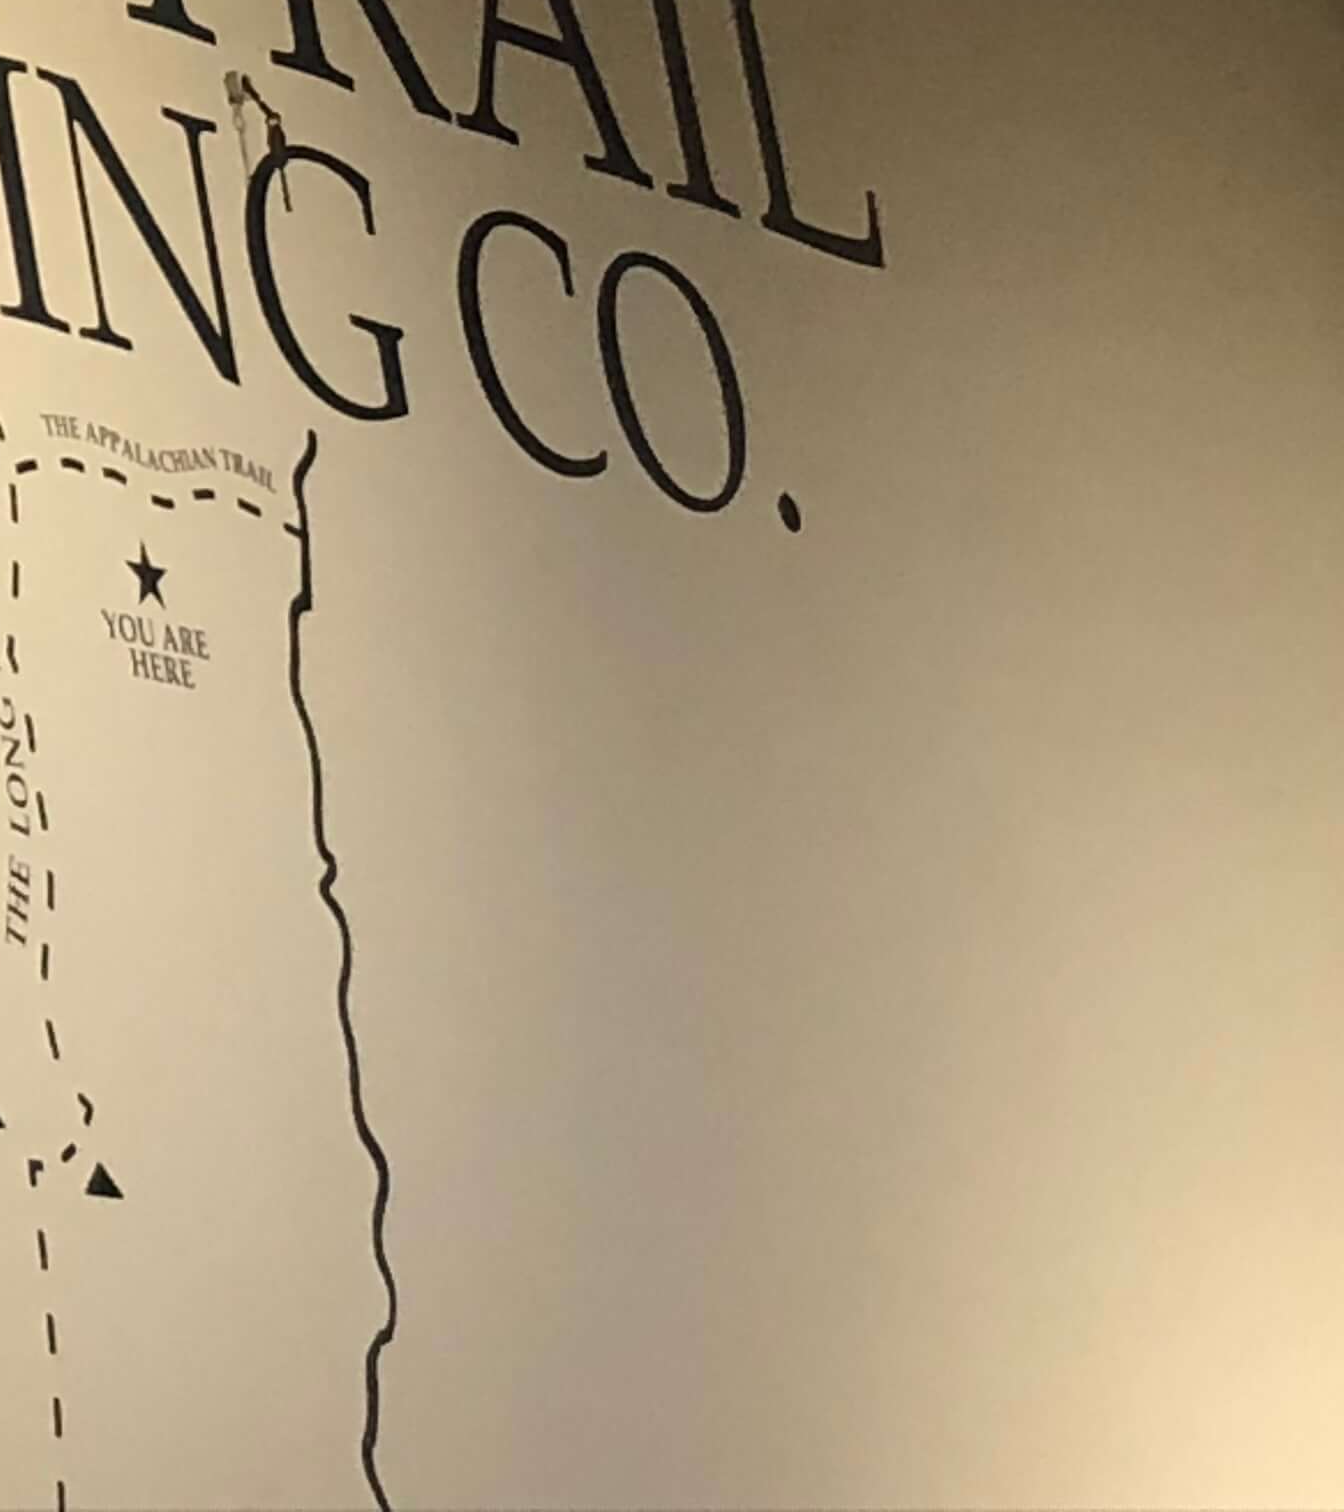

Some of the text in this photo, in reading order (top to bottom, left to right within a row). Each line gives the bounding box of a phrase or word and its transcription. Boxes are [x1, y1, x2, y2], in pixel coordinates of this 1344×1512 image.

[458, 209, 801, 532] CO.
[40, 412, 279, 494] THE APPALACHIAN TRAIL
[101, 608, 211, 661] YOU ARE
[128, 647, 196, 690] HERE
[4, 855, 32, 948] THE
